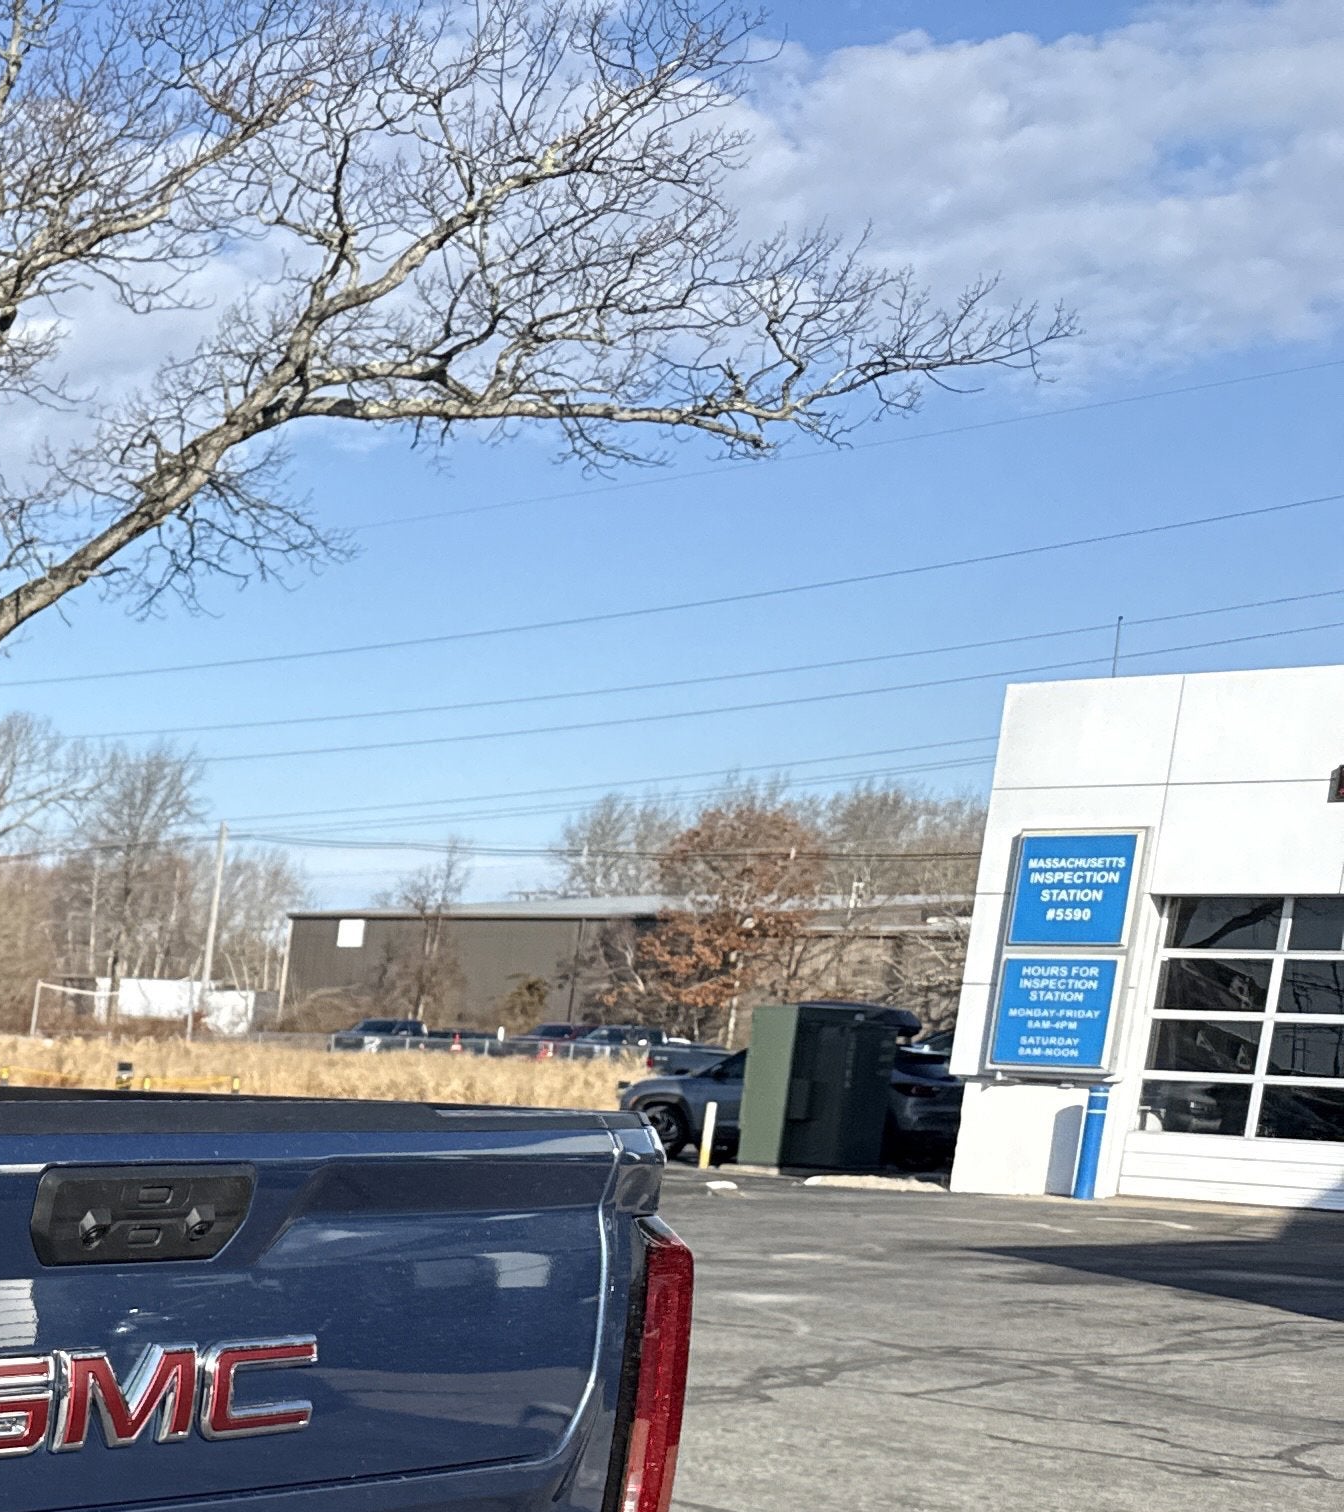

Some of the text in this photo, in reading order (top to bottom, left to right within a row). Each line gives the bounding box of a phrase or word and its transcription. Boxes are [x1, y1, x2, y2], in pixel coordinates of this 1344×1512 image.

[1028, 857, 1126, 869] MASSACHUSETTS
[1030, 871, 1120, 883] INSPECTION
[1040, 889, 1103, 901] STATION
[1046, 908, 1091, 921] #5590
[1021, 966, 1099, 977] HOURS FOR
[1019, 978, 1099, 990] INSPECTION
[1029, 990, 1084, 1002] STATION
[1008, 1008, 1101, 1019] MONDAY-FRIDAY
[1019, 1036, 1080, 1045] SATURDAY
